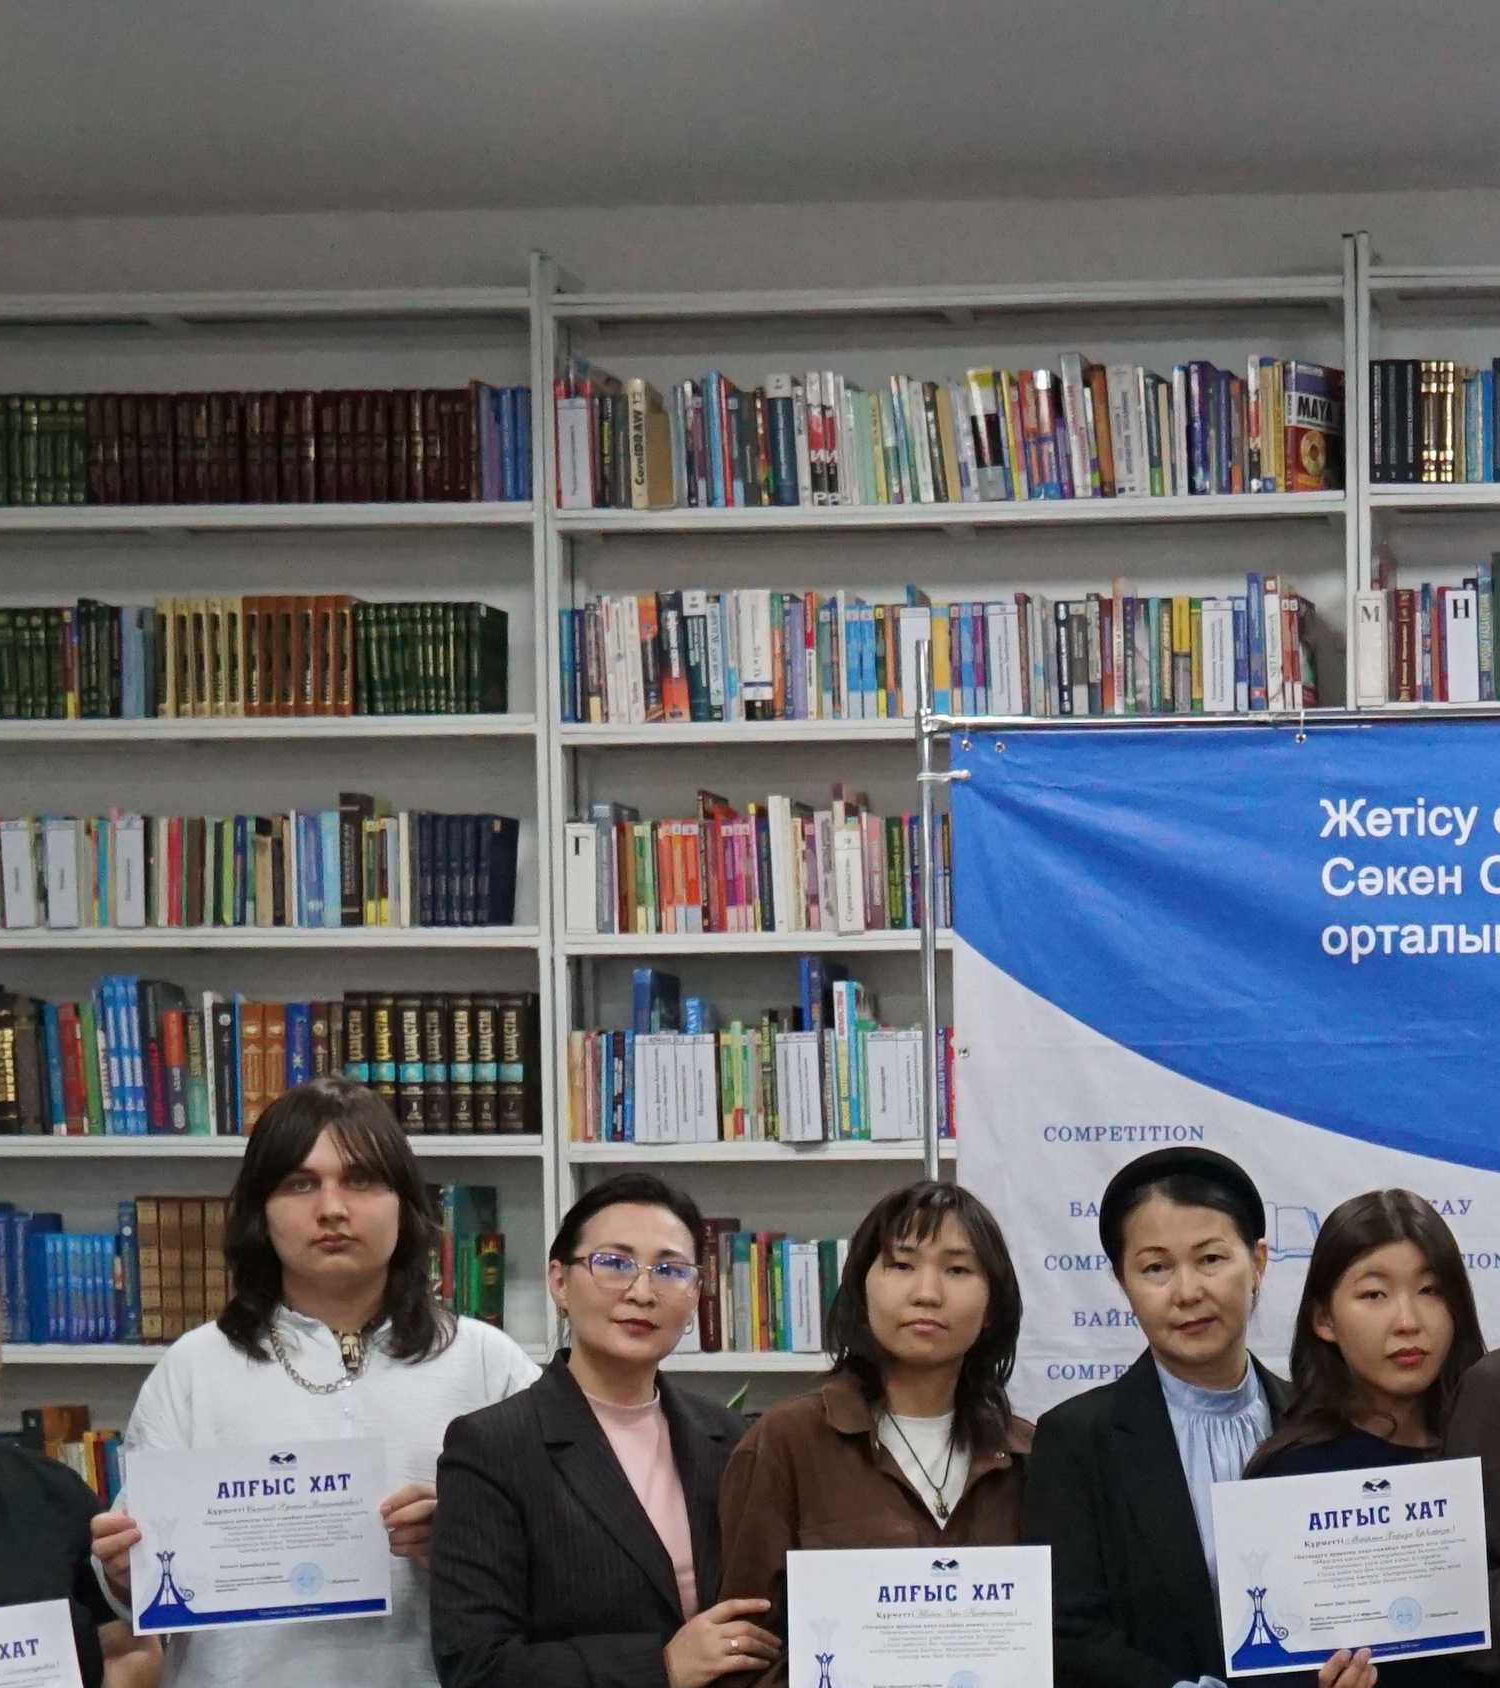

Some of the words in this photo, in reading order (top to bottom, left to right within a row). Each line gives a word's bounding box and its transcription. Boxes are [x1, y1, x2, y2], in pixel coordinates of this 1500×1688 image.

[1298, 394, 1334, 424] MAYA
[1361, 605, 1380, 623] М
[1452, 598, 1470, 619] Н
[1320, 797, 1478, 845] Жетісу
[1321, 857, 1462, 897] Сәкен
[1043, 1125, 1205, 1143] COMPETITION
[217, 1477, 296, 1499] АЛҒЫС
[309, 1473, 351, 1493] ХАТ
[1308, 1505, 1391, 1531] АЛҒЫС
[1405, 1498, 1448, 1522] ХАТ
[877, 1584, 957, 1603] АЛҒЫС
[972, 1582, 1015, 1601] ХАТ
